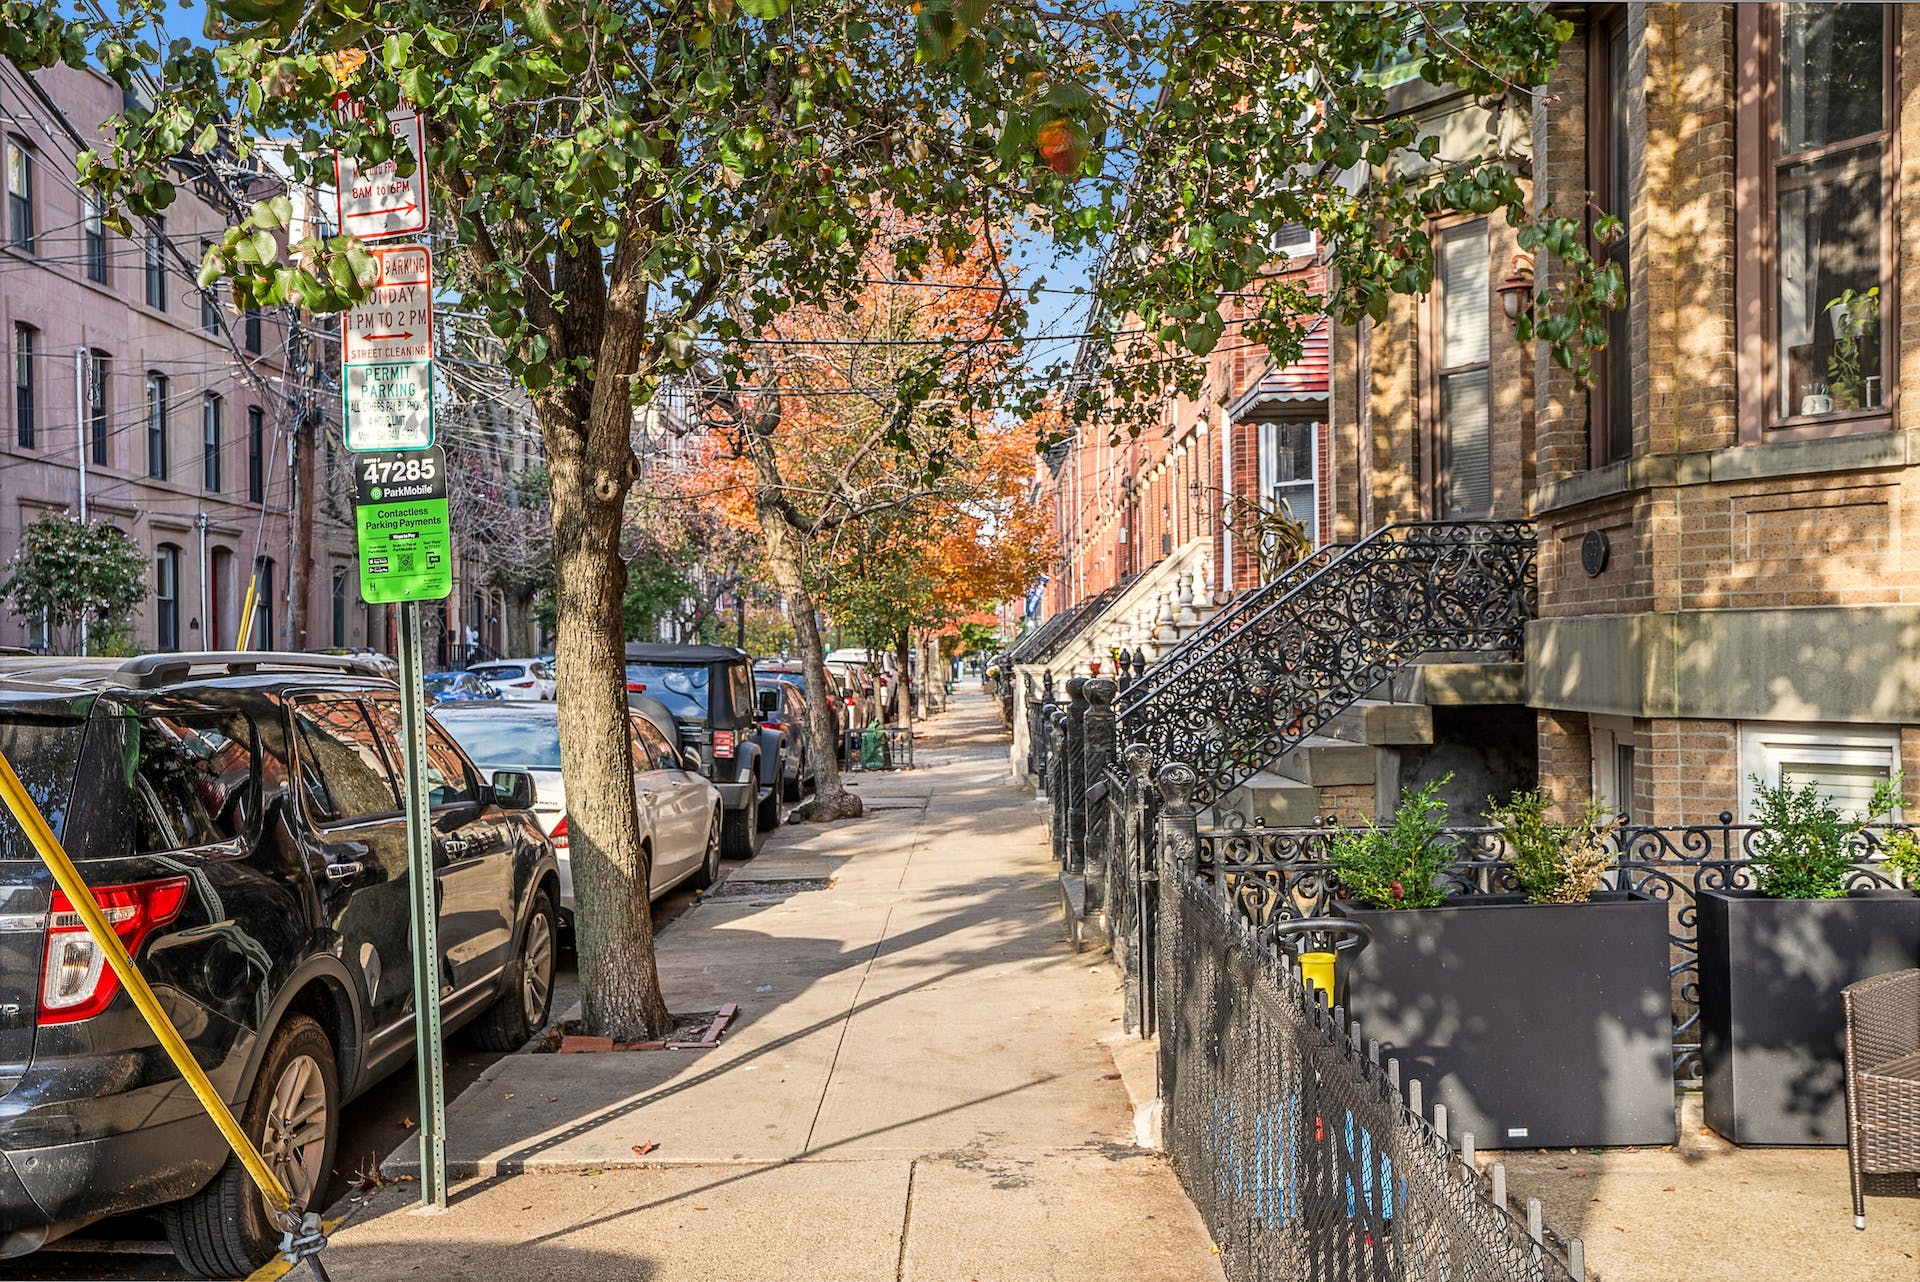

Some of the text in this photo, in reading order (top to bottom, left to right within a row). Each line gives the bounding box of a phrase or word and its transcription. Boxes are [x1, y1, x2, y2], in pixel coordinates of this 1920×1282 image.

[352, 180, 410, 199] 8AM to 6PM
[362, 286, 416, 305] ONDAY
[348, 309, 427, 330] 1 PM TO 2 PM
[351, 345, 426, 360] STREET CLEANING
[365, 365, 411, 381] PERMIT
[361, 382, 416, 398] PARKING
[363, 458, 436, 485] 47285
[383, 484, 431, 498] ParkMobile
[377, 507, 429, 519] Contactless
[366, 516, 442, 530] Parking Payments
[370, 582, 376, 592] H
